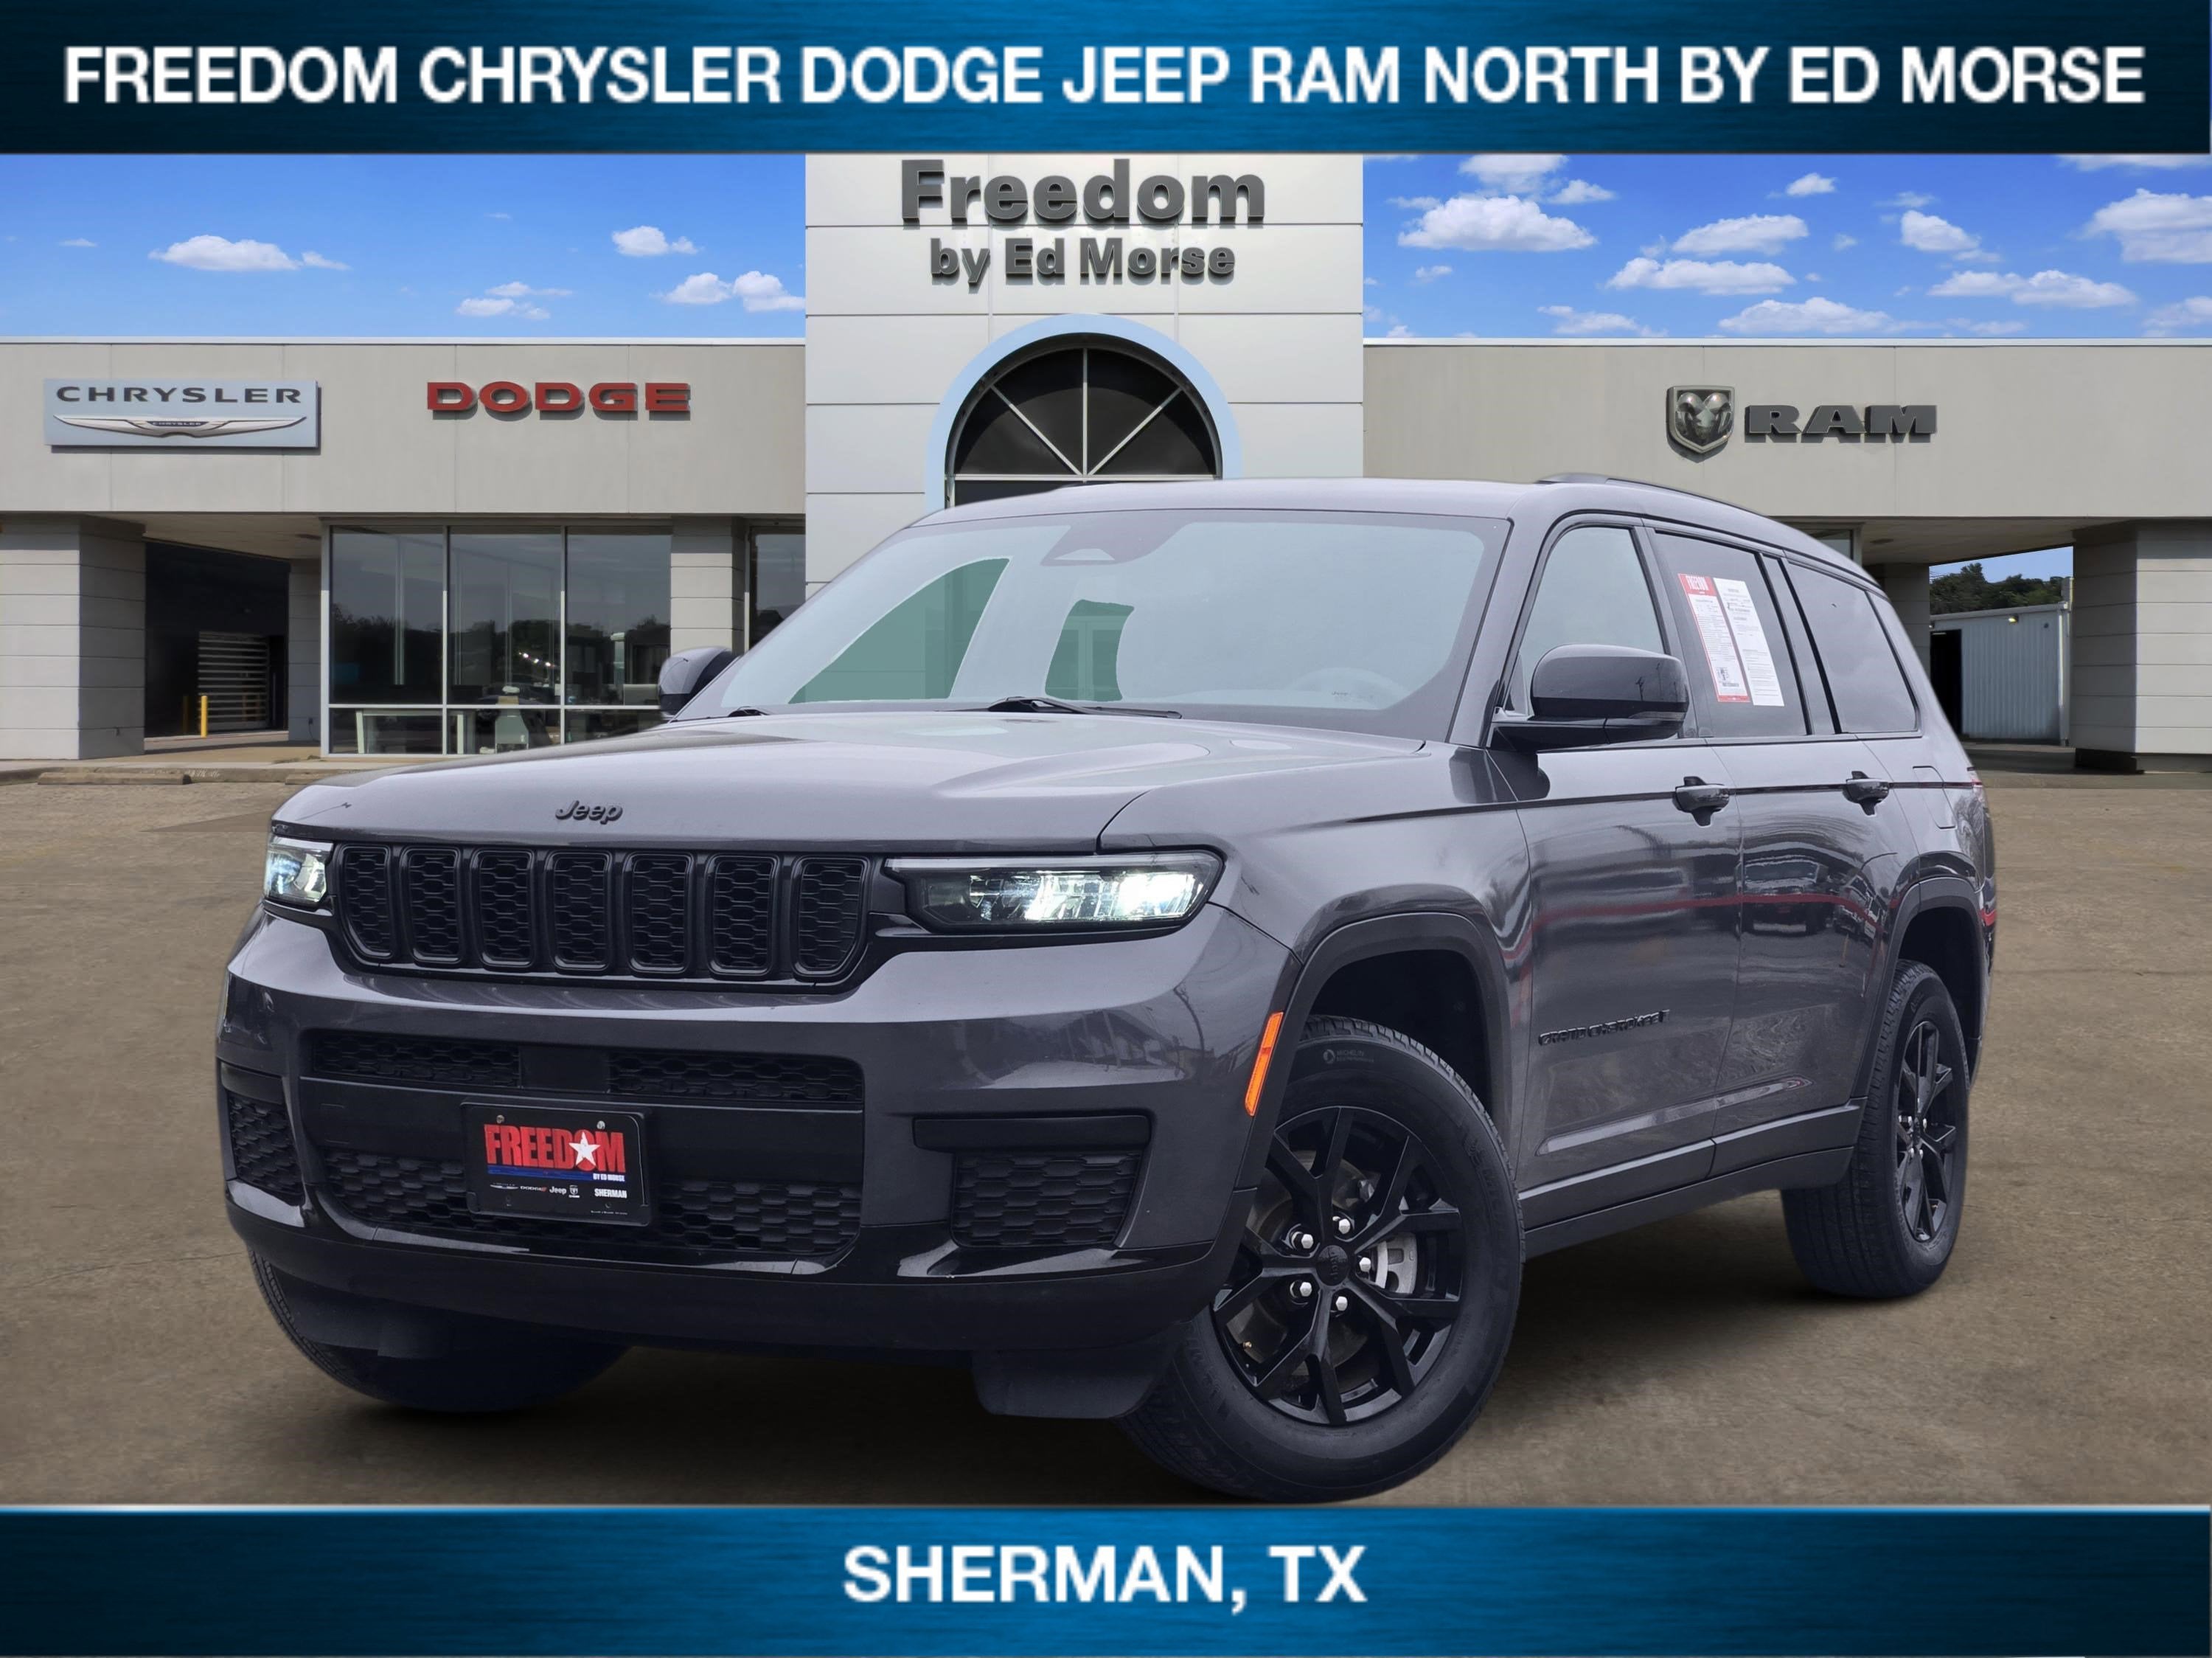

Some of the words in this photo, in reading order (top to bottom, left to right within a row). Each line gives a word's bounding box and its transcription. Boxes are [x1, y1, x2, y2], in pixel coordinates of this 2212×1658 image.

[902, 159, 1265, 222] Freedom
[931, 237, 990, 288] by
[1005, 237, 1065, 278] Ed
[1080, 237, 1236, 278] Morse
[56, 386, 302, 403] CHRYSLER
[427, 381, 690, 412] DODGE
[1745, 405, 1937, 434] RAM
[555, 800, 623, 825] Jeep
[484, 1124, 626, 1173] FREEDOM
[549, 1186, 567, 1196] Jeep
[594, 1188, 627, 1199] SHERMAN
